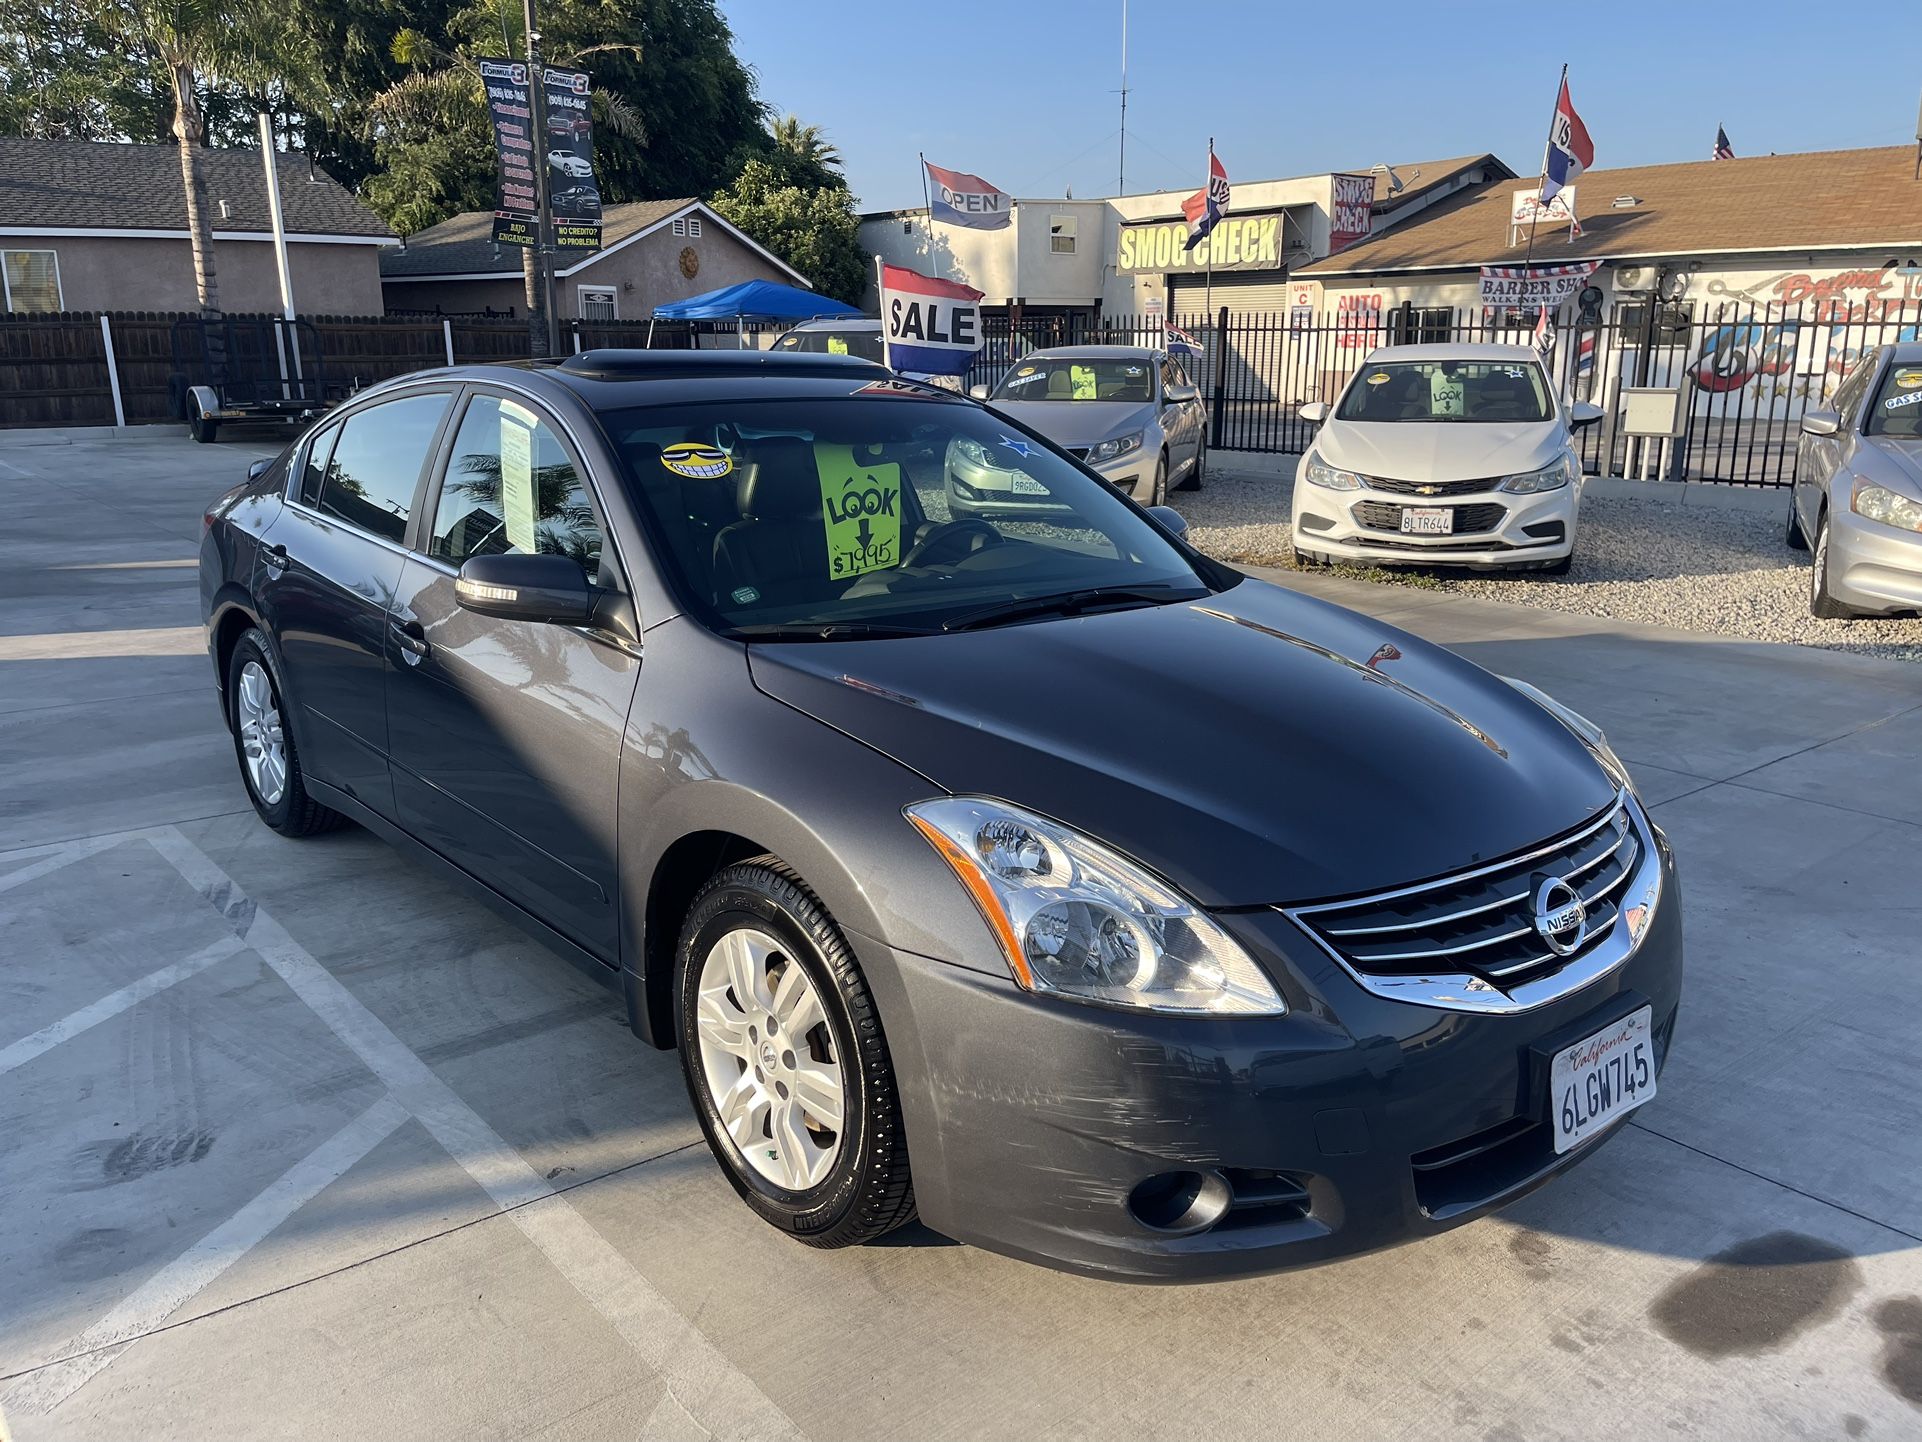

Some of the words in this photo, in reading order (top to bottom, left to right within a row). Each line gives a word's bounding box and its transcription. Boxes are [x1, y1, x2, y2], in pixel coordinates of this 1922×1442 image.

[1335, 178, 1373, 204] SMOG
[942, 187, 998, 212] OPEN
[1333, 206, 1371, 233] CHECK
[510, 223, 526, 234] BAJO
[558, 227, 568, 236] NO
[568, 227, 598, 236] CREDITO?
[498, 232, 535, 245] ENGANCHE
[557, 237, 567, 245] NO
[567, 238, 599, 246] PROBLEMA
[1120, 224, 1188, 270] SMOG
[1192, 217, 1279, 266] CHECK
[1293, 284, 1314, 292] UNIT
[1482, 280, 1552, 295] BARBER
[1298, 293, 1308, 305] C
[1338, 293, 1382, 311] AUTO
[1482, 295, 1537, 304] WALK-INS
[891, 298, 976, 345] SALE
[1167, 330, 1201, 347] SALE
[1433, 390, 1462, 402] LOOK
[1886, 394, 1911, 408] GAS
[826, 487, 899, 525] LOOK
[1404, 516, 1449, 530] 8LTR644
[1573, 1031, 1632, 1071] California
[1562, 1043, 1649, 1134] 6LGW745
